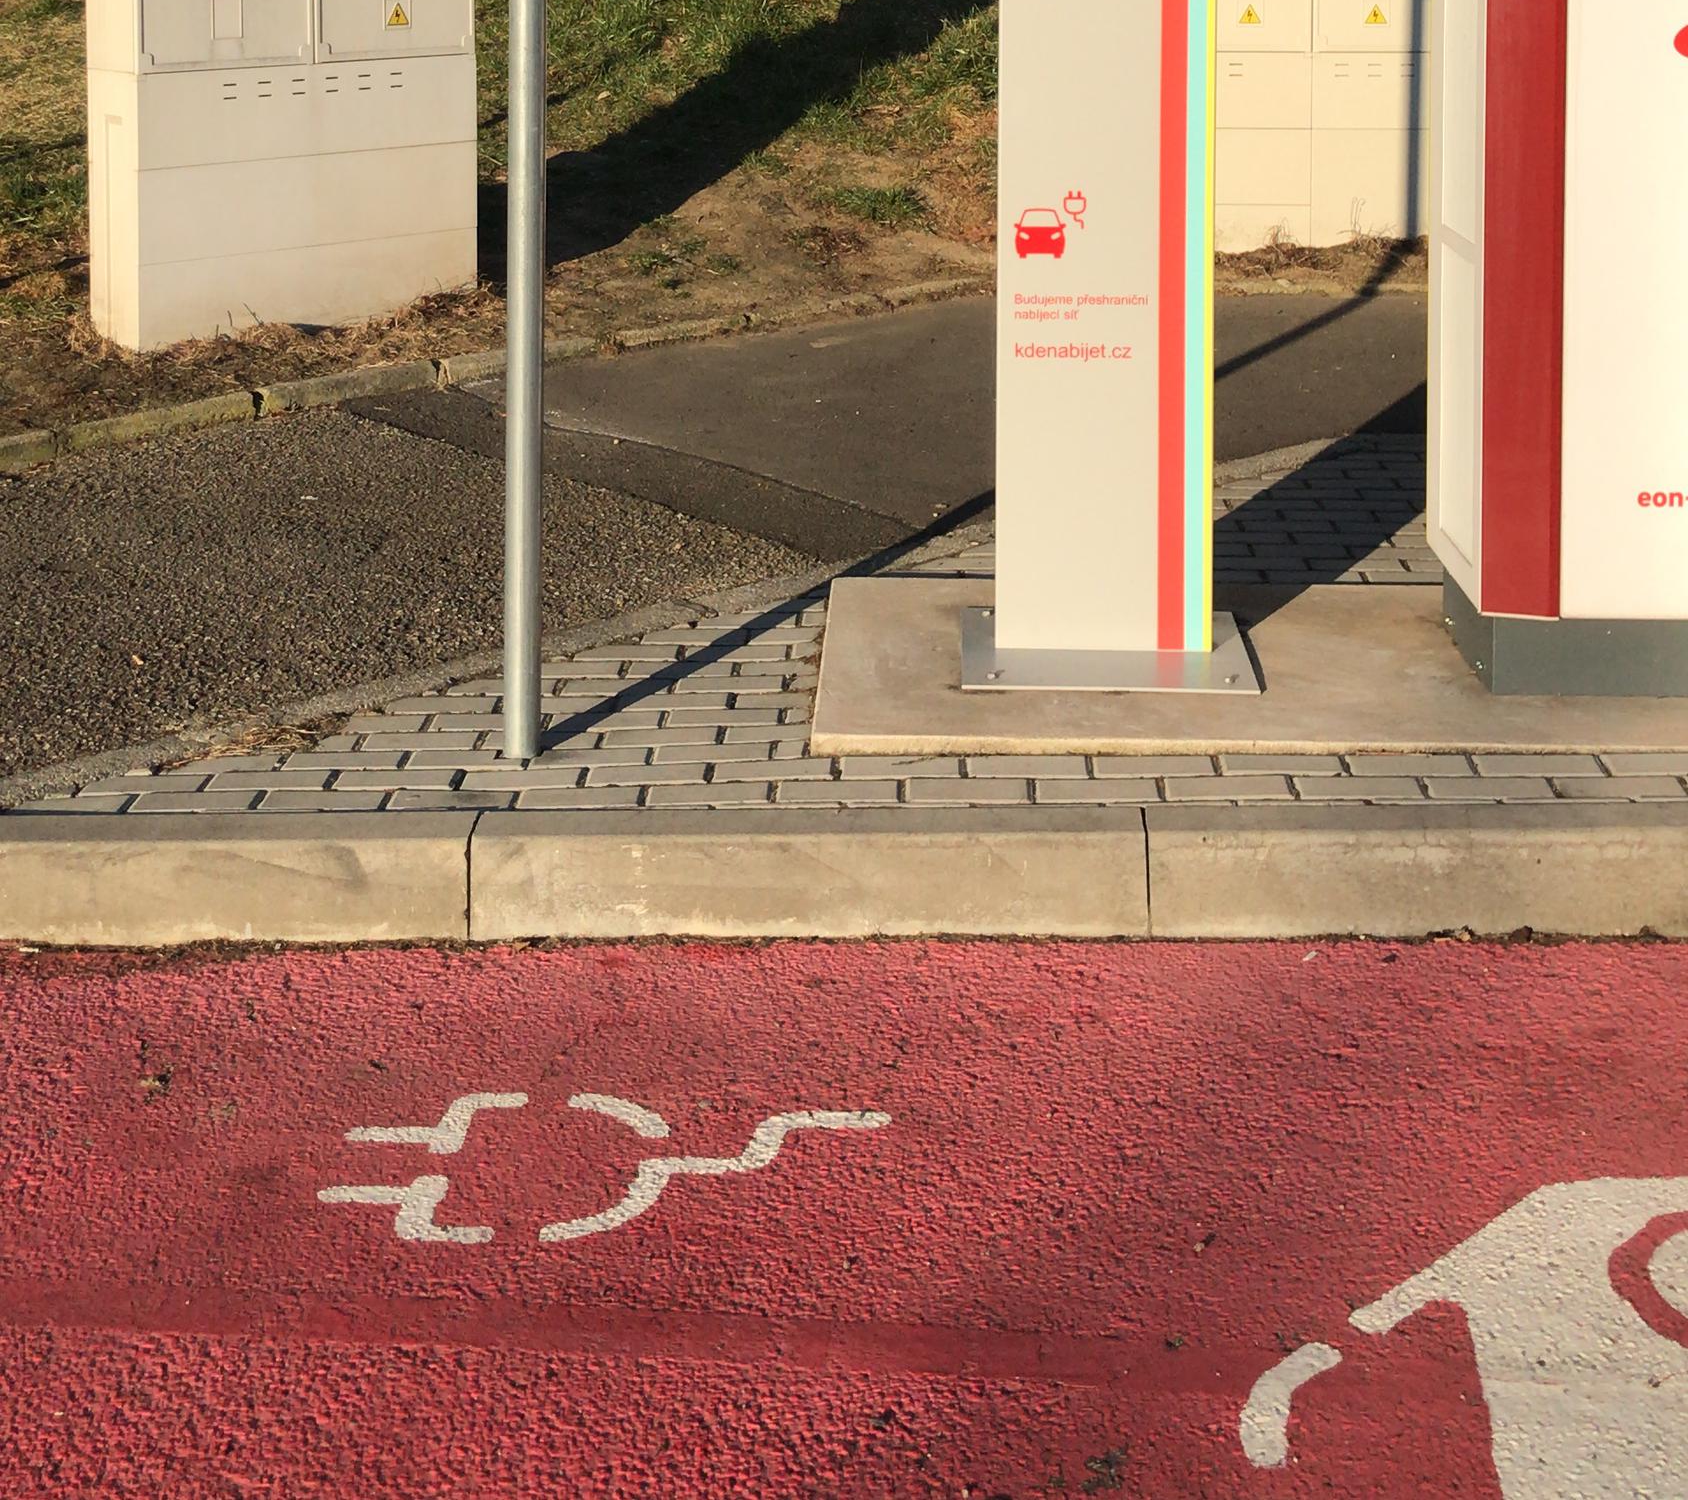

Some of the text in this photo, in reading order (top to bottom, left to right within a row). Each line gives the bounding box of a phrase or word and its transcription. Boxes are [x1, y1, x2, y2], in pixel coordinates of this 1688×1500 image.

[1014, 293, 1149, 307] Budujeme přeshraniční
[1014, 309, 1060, 322] nabíjecí
[1015, 342, 1132, 362] kdenabijet.cz
